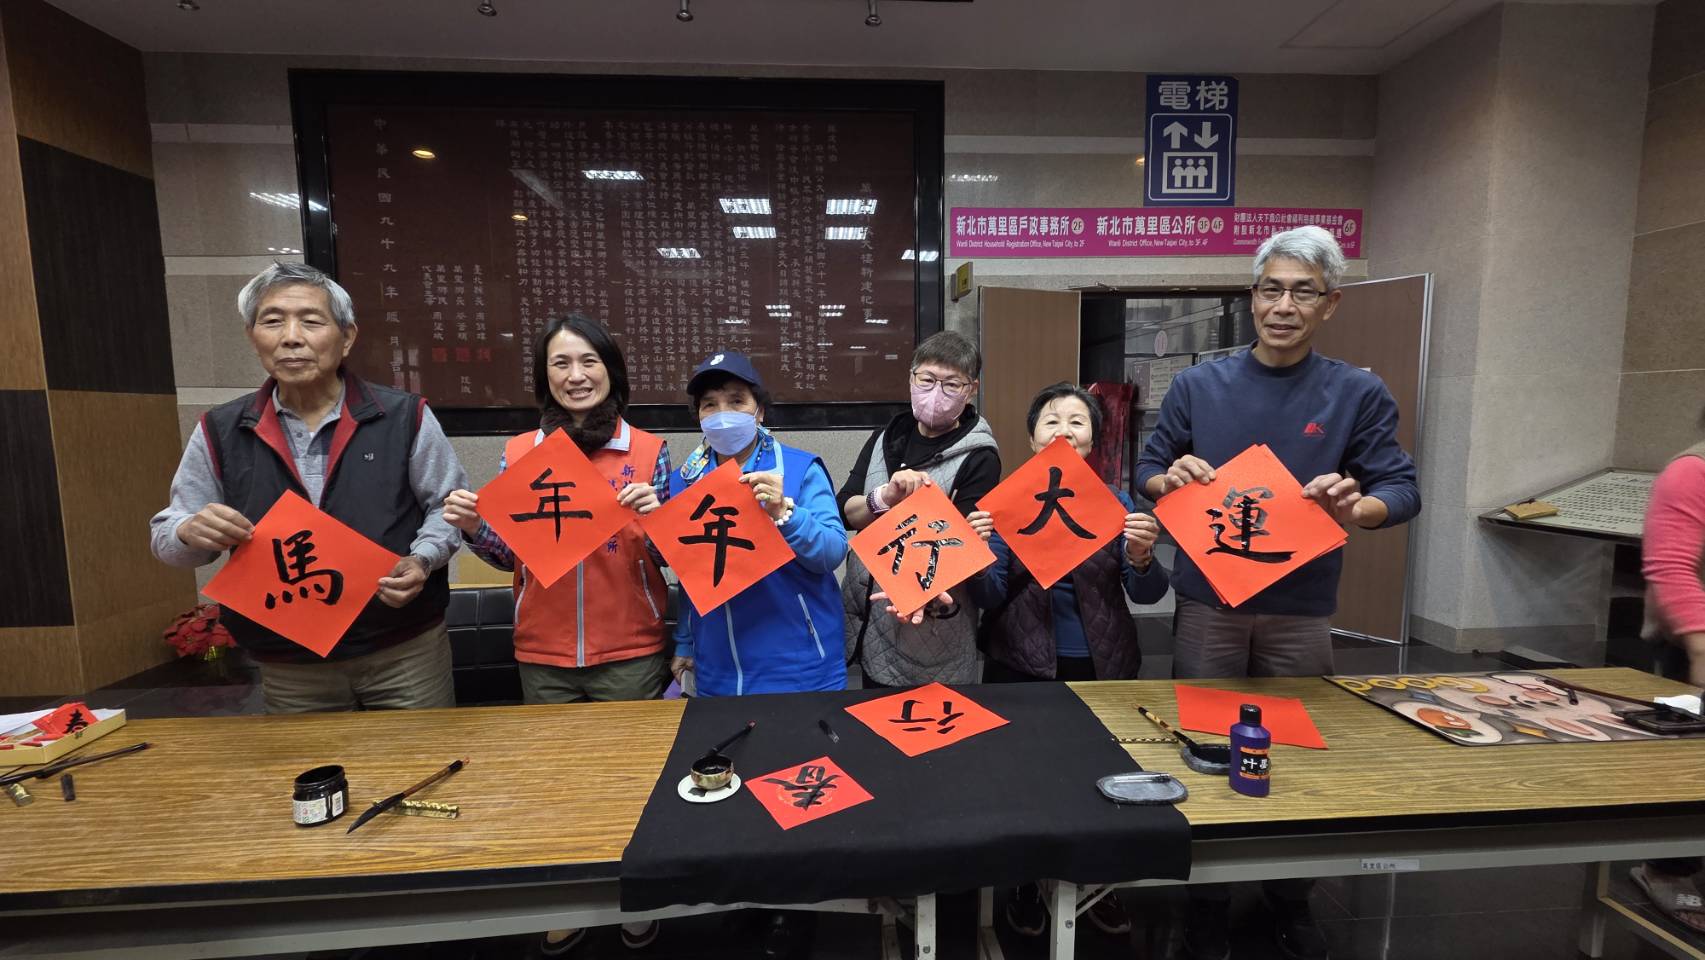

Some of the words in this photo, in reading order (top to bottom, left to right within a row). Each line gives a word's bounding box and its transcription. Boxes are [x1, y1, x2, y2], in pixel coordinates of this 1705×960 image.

[1158, 80, 1230, 111] 電梯
[956, 215, 1070, 237] 新北市萬里區戶政事務所
[1073, 222, 1083, 231] 2F
[1006, 240, 1029, 248] Registration
[1052, 240, 1064, 248] Taipei
[1096, 215, 1196, 236] 新北市萬里區公所
[1199, 221, 1209, 230] 3F
[1213, 221, 1223, 230] 4F
[1154, 239, 1164, 247] New
[1164, 239, 1178, 247] Taipei
[511, 468, 593, 543] 年
[1017, 467, 1097, 540] 大
[1205, 486, 1298, 564] 運
[265, 530, 344, 610] 馬
[678, 494, 755, 587] 年
[877, 513, 965, 592] 行
[762, 766, 842, 811] 春
